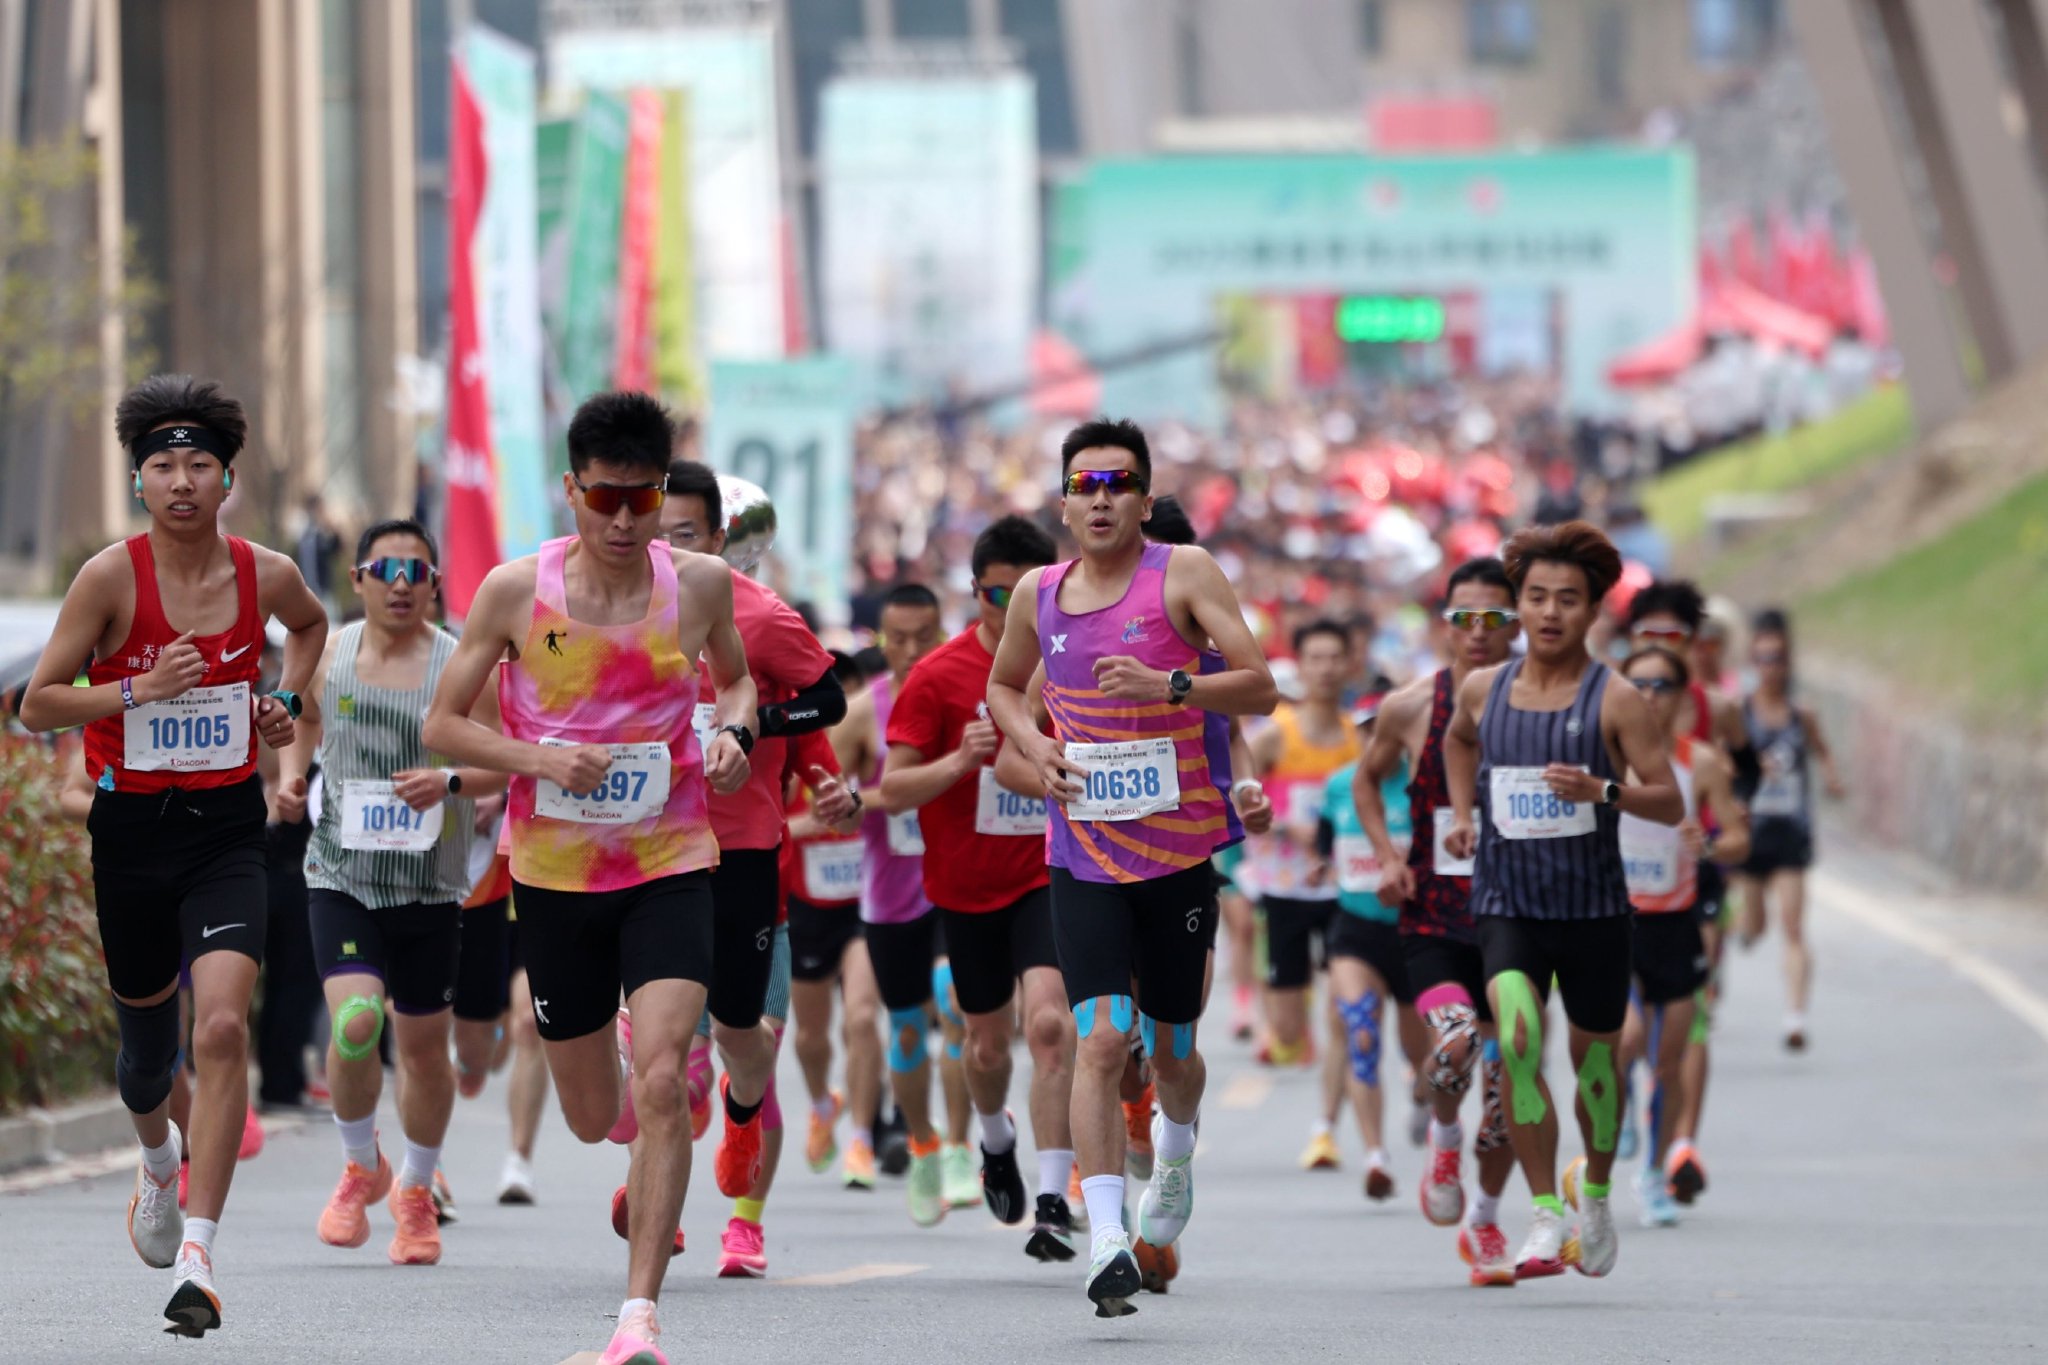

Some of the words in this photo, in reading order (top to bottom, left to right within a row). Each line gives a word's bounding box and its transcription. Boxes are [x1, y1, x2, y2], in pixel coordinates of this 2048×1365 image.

[149, 714, 230, 749] 10105
[561, 771, 648, 802] 697
[1085, 766, 1160, 800] 10638
[362, 805, 424, 831] 10147
[587, 811, 622, 819] QIAODAN
